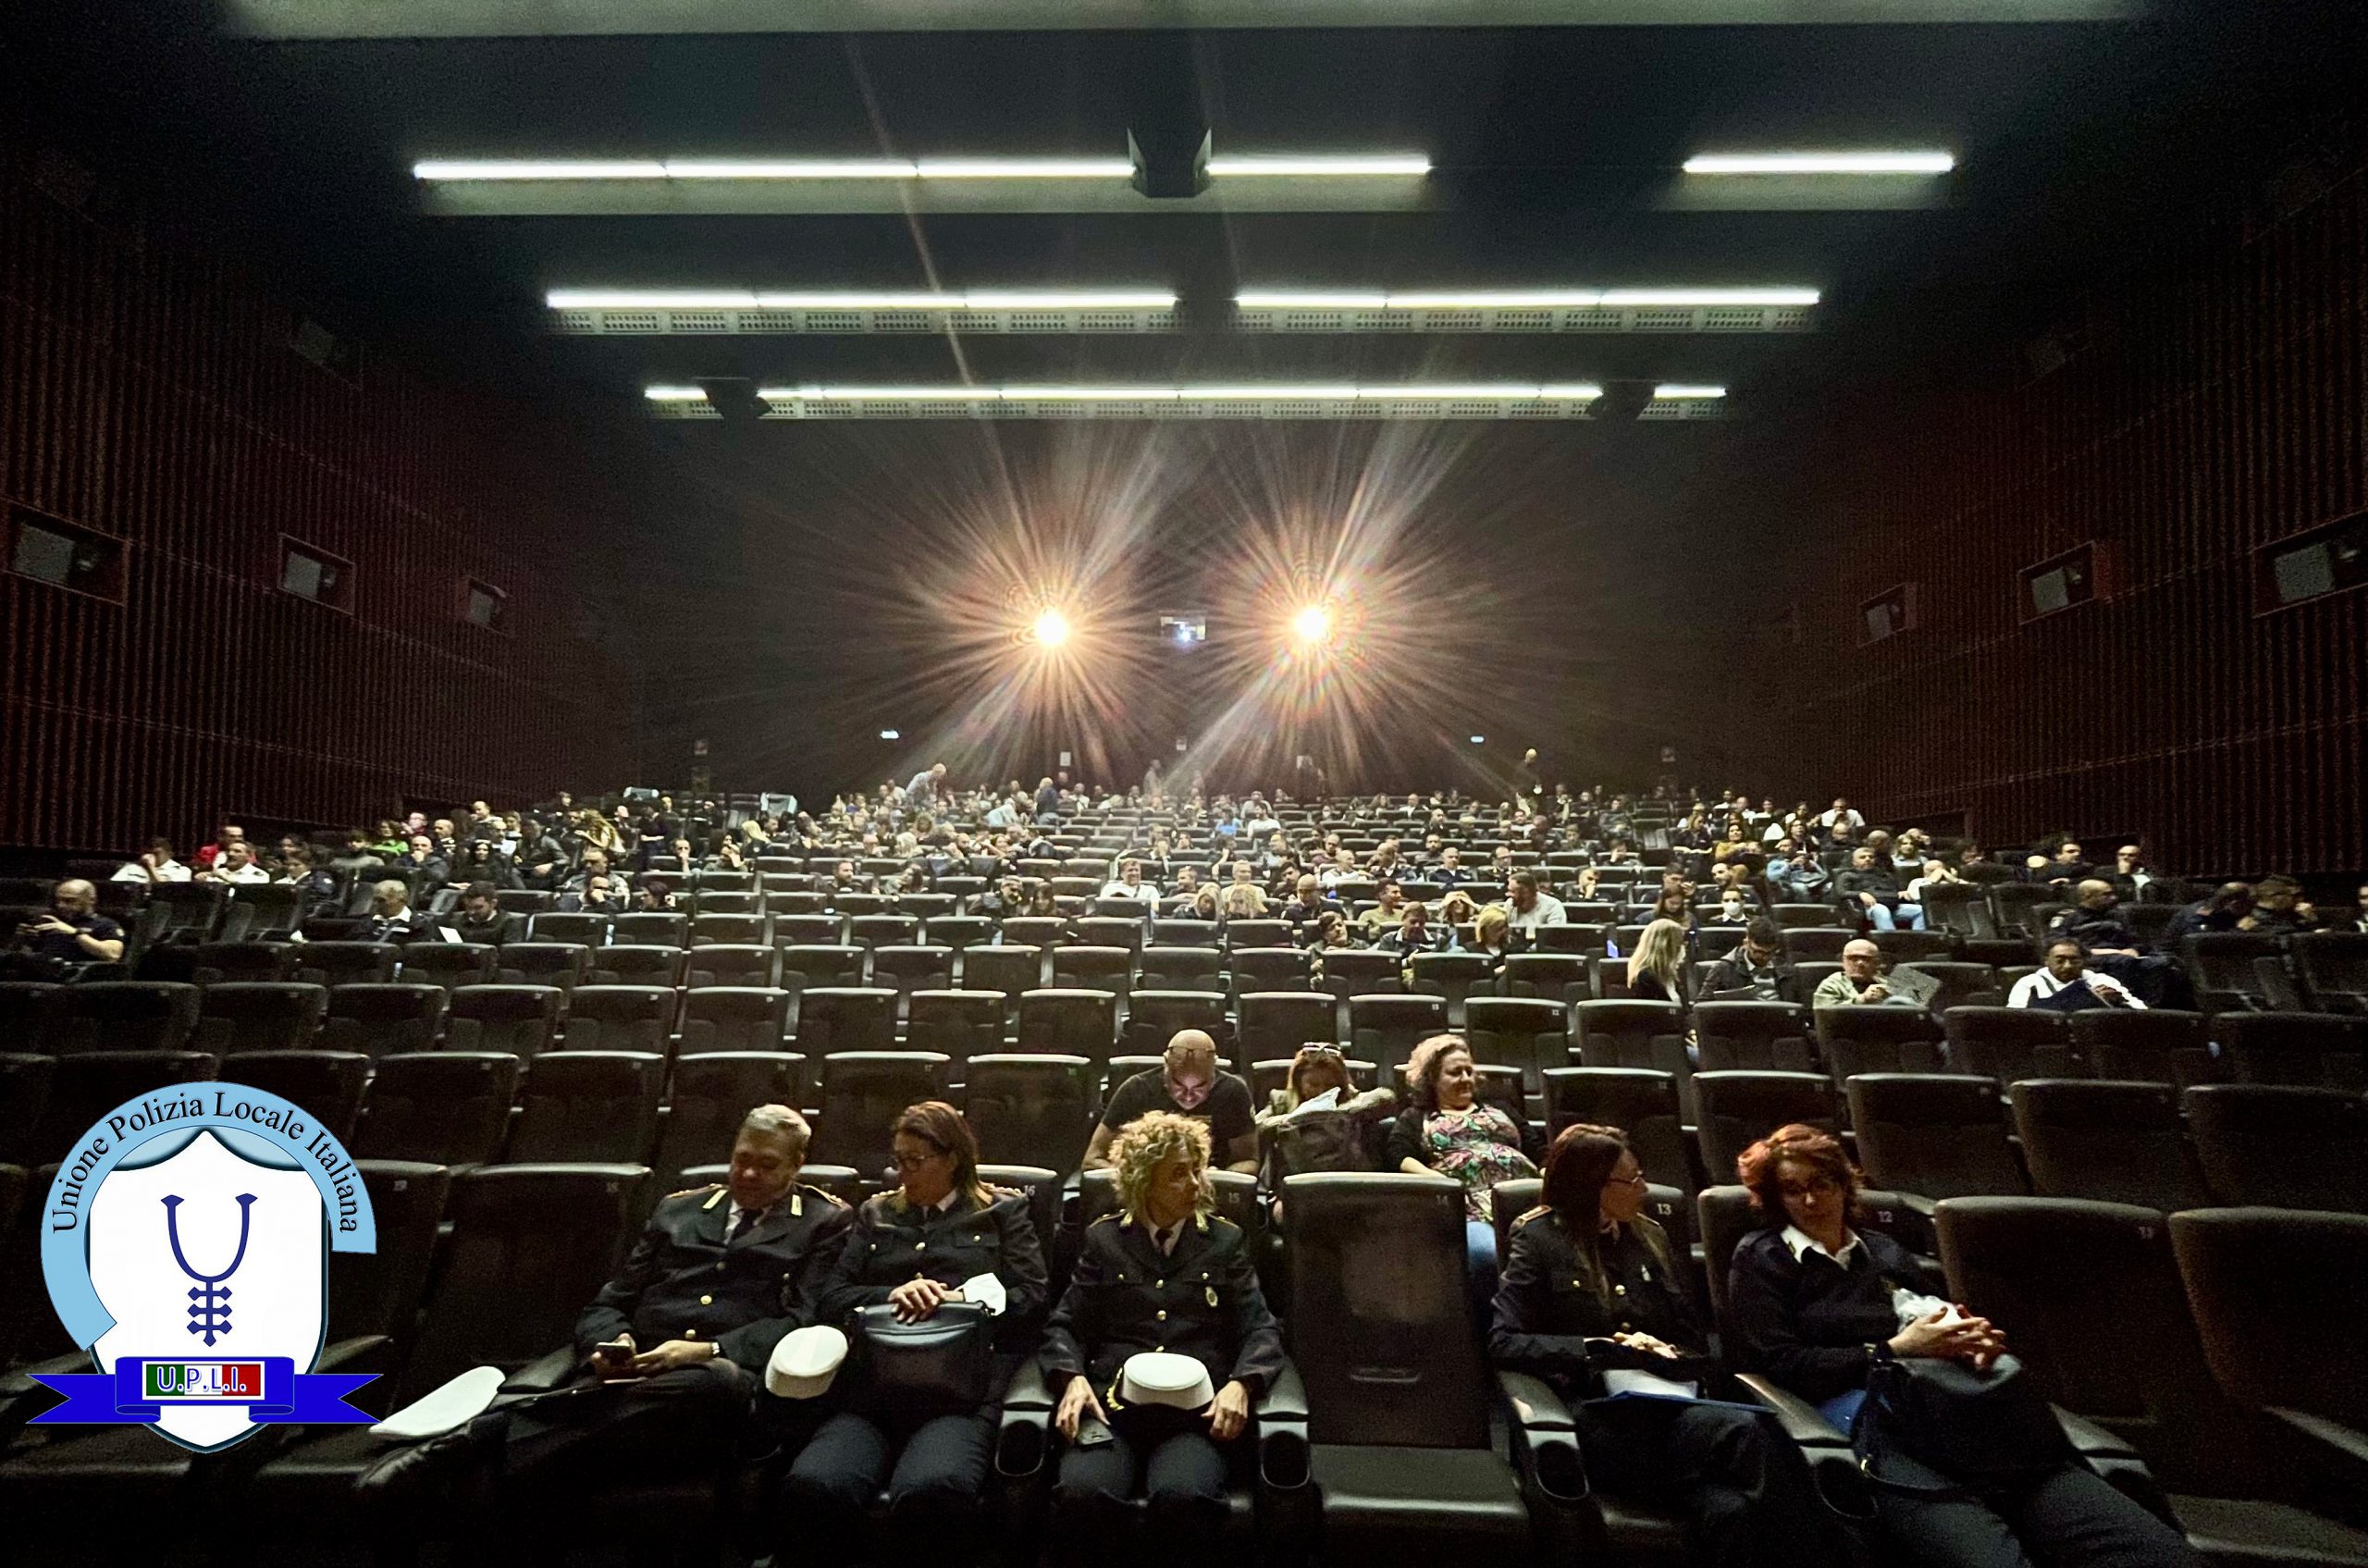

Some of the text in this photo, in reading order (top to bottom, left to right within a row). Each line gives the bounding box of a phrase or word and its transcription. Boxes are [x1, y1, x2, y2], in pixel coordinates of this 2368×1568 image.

[1023, 1185, 1036, 1196] 16
[1228, 1191, 1240, 1204] 15
[1436, 1194, 1449, 1206] 14
[1657, 1204, 1672, 1216] 13
[1878, 1210, 1893, 1223] 12
